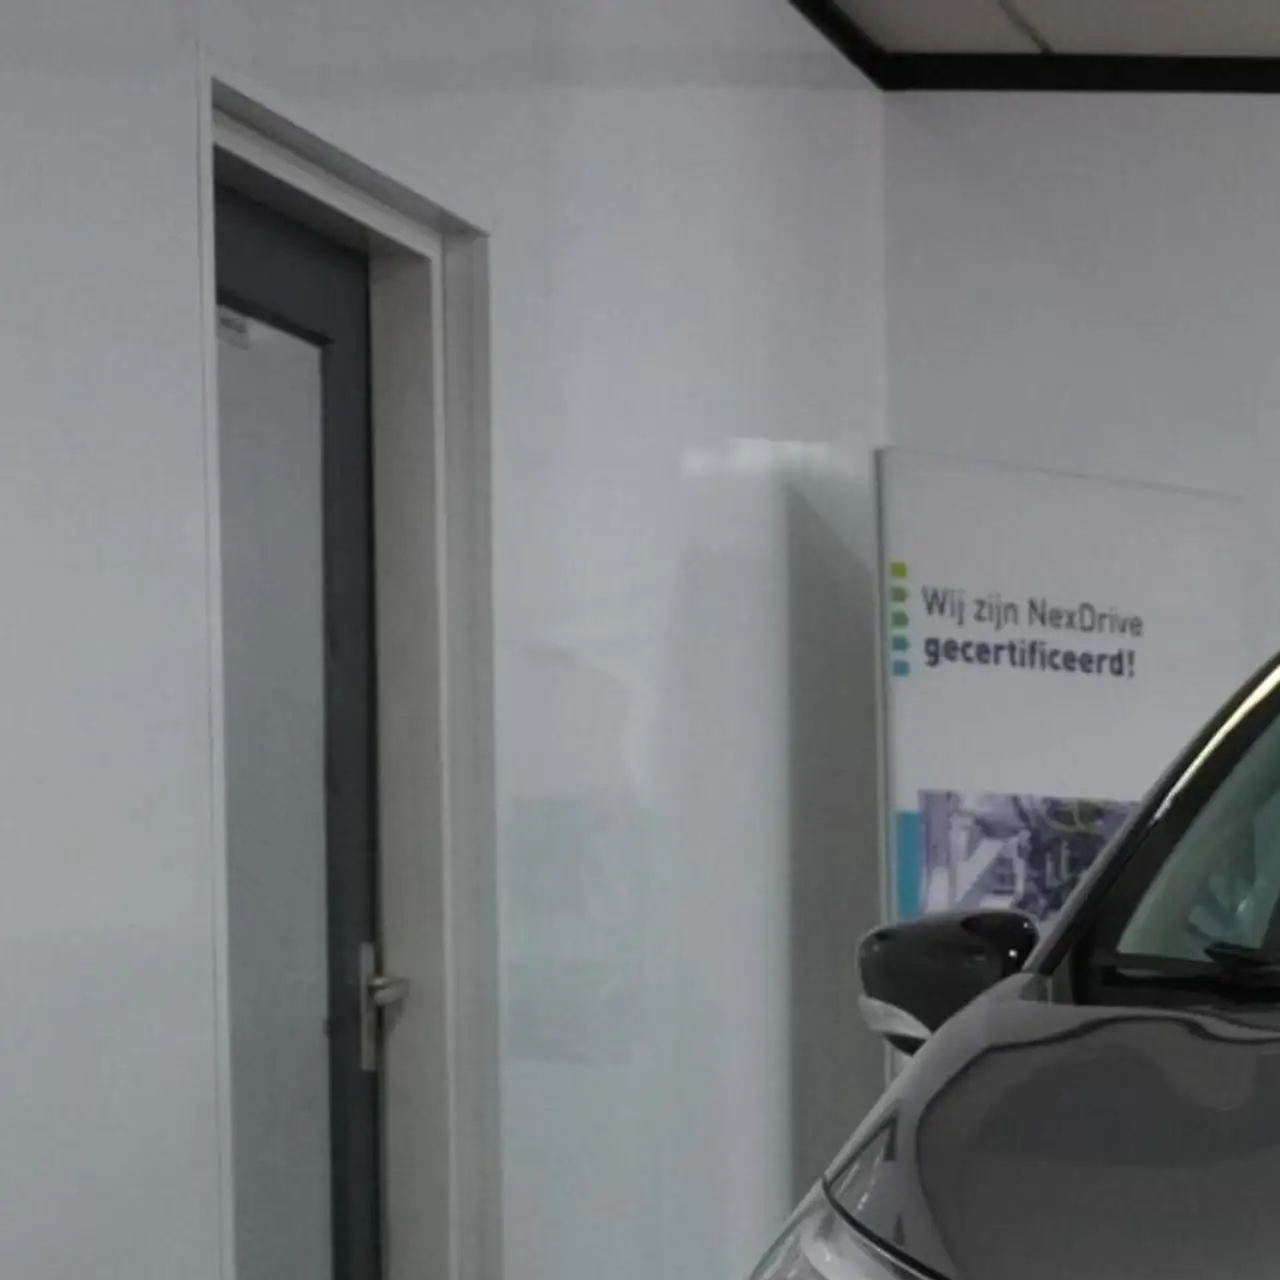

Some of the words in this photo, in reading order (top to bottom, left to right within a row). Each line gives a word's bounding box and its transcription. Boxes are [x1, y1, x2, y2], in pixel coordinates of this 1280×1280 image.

[922, 586, 964, 626] Wij
[973, 594, 1019, 631] zijn
[1028, 598, 1144, 638] NexDrive
[924, 634, 1136, 677] gecertificeerd!
